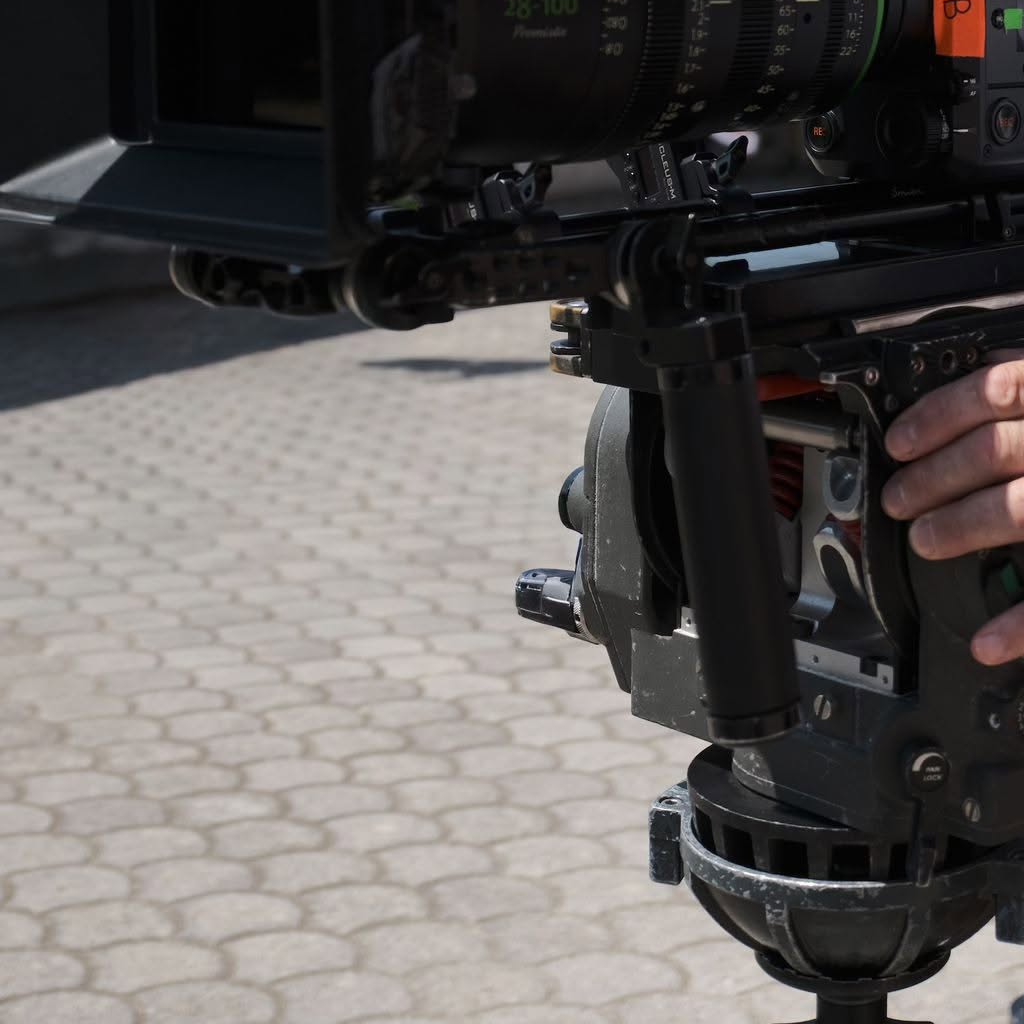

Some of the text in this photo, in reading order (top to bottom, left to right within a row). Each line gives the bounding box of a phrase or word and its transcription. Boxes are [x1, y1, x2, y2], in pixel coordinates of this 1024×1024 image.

[779, 5, 792, 17] 65
[848, 12, 858, 24] 11
[777, 24, 790, 36] 60
[846, 31, 857, 41] 16
[773, 45, 786, 57] 55
[839, 47, 853, 56] 22
